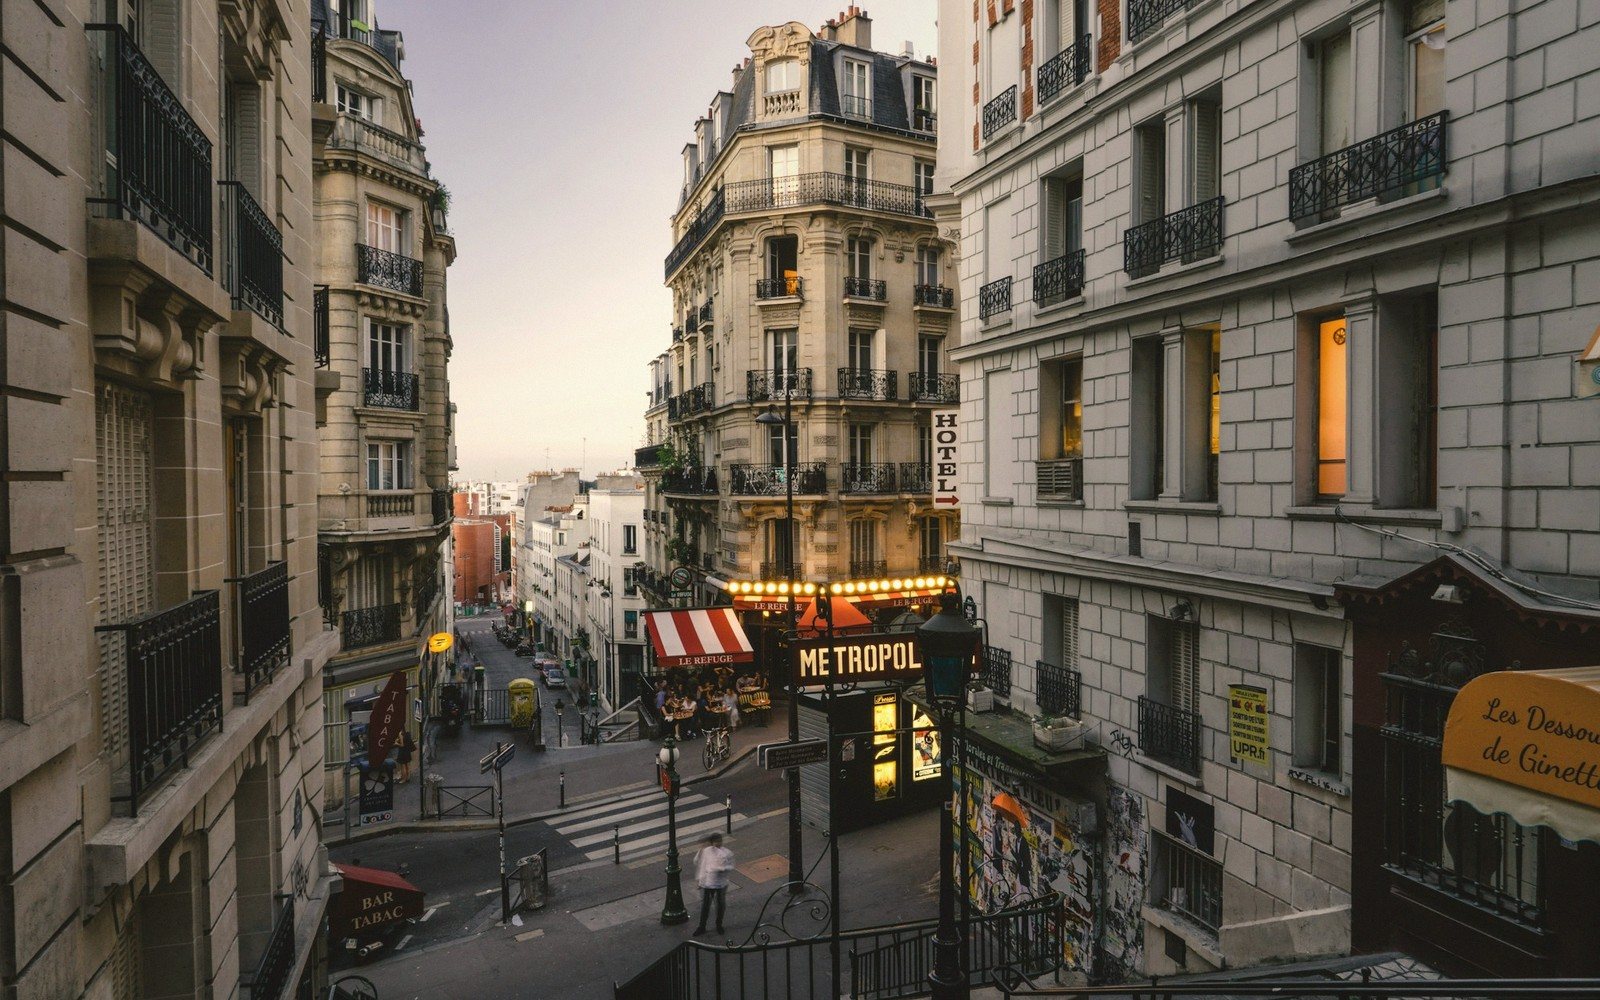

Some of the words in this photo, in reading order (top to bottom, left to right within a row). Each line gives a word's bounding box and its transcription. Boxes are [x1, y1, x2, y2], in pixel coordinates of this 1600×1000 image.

[935, 414, 958, 492] HOTEL
[754, 602, 766, 610] LE
[767, 602, 803, 611] REFUE
[678, 657, 692, 666] LE
[694, 655, 734, 664] REFUGE
[800, 642, 922, 677] METROPOL
[378, 691, 399, 747] TABAC
[1482, 698, 1520, 725] Les
[1233, 740, 1265, 760] UPR.fr
[1482, 736, 1511, 764] de
[1519, 743, 1600, 791] Ginett
[362, 891, 394, 910] BAR
[351, 905, 403, 930] TABAC
